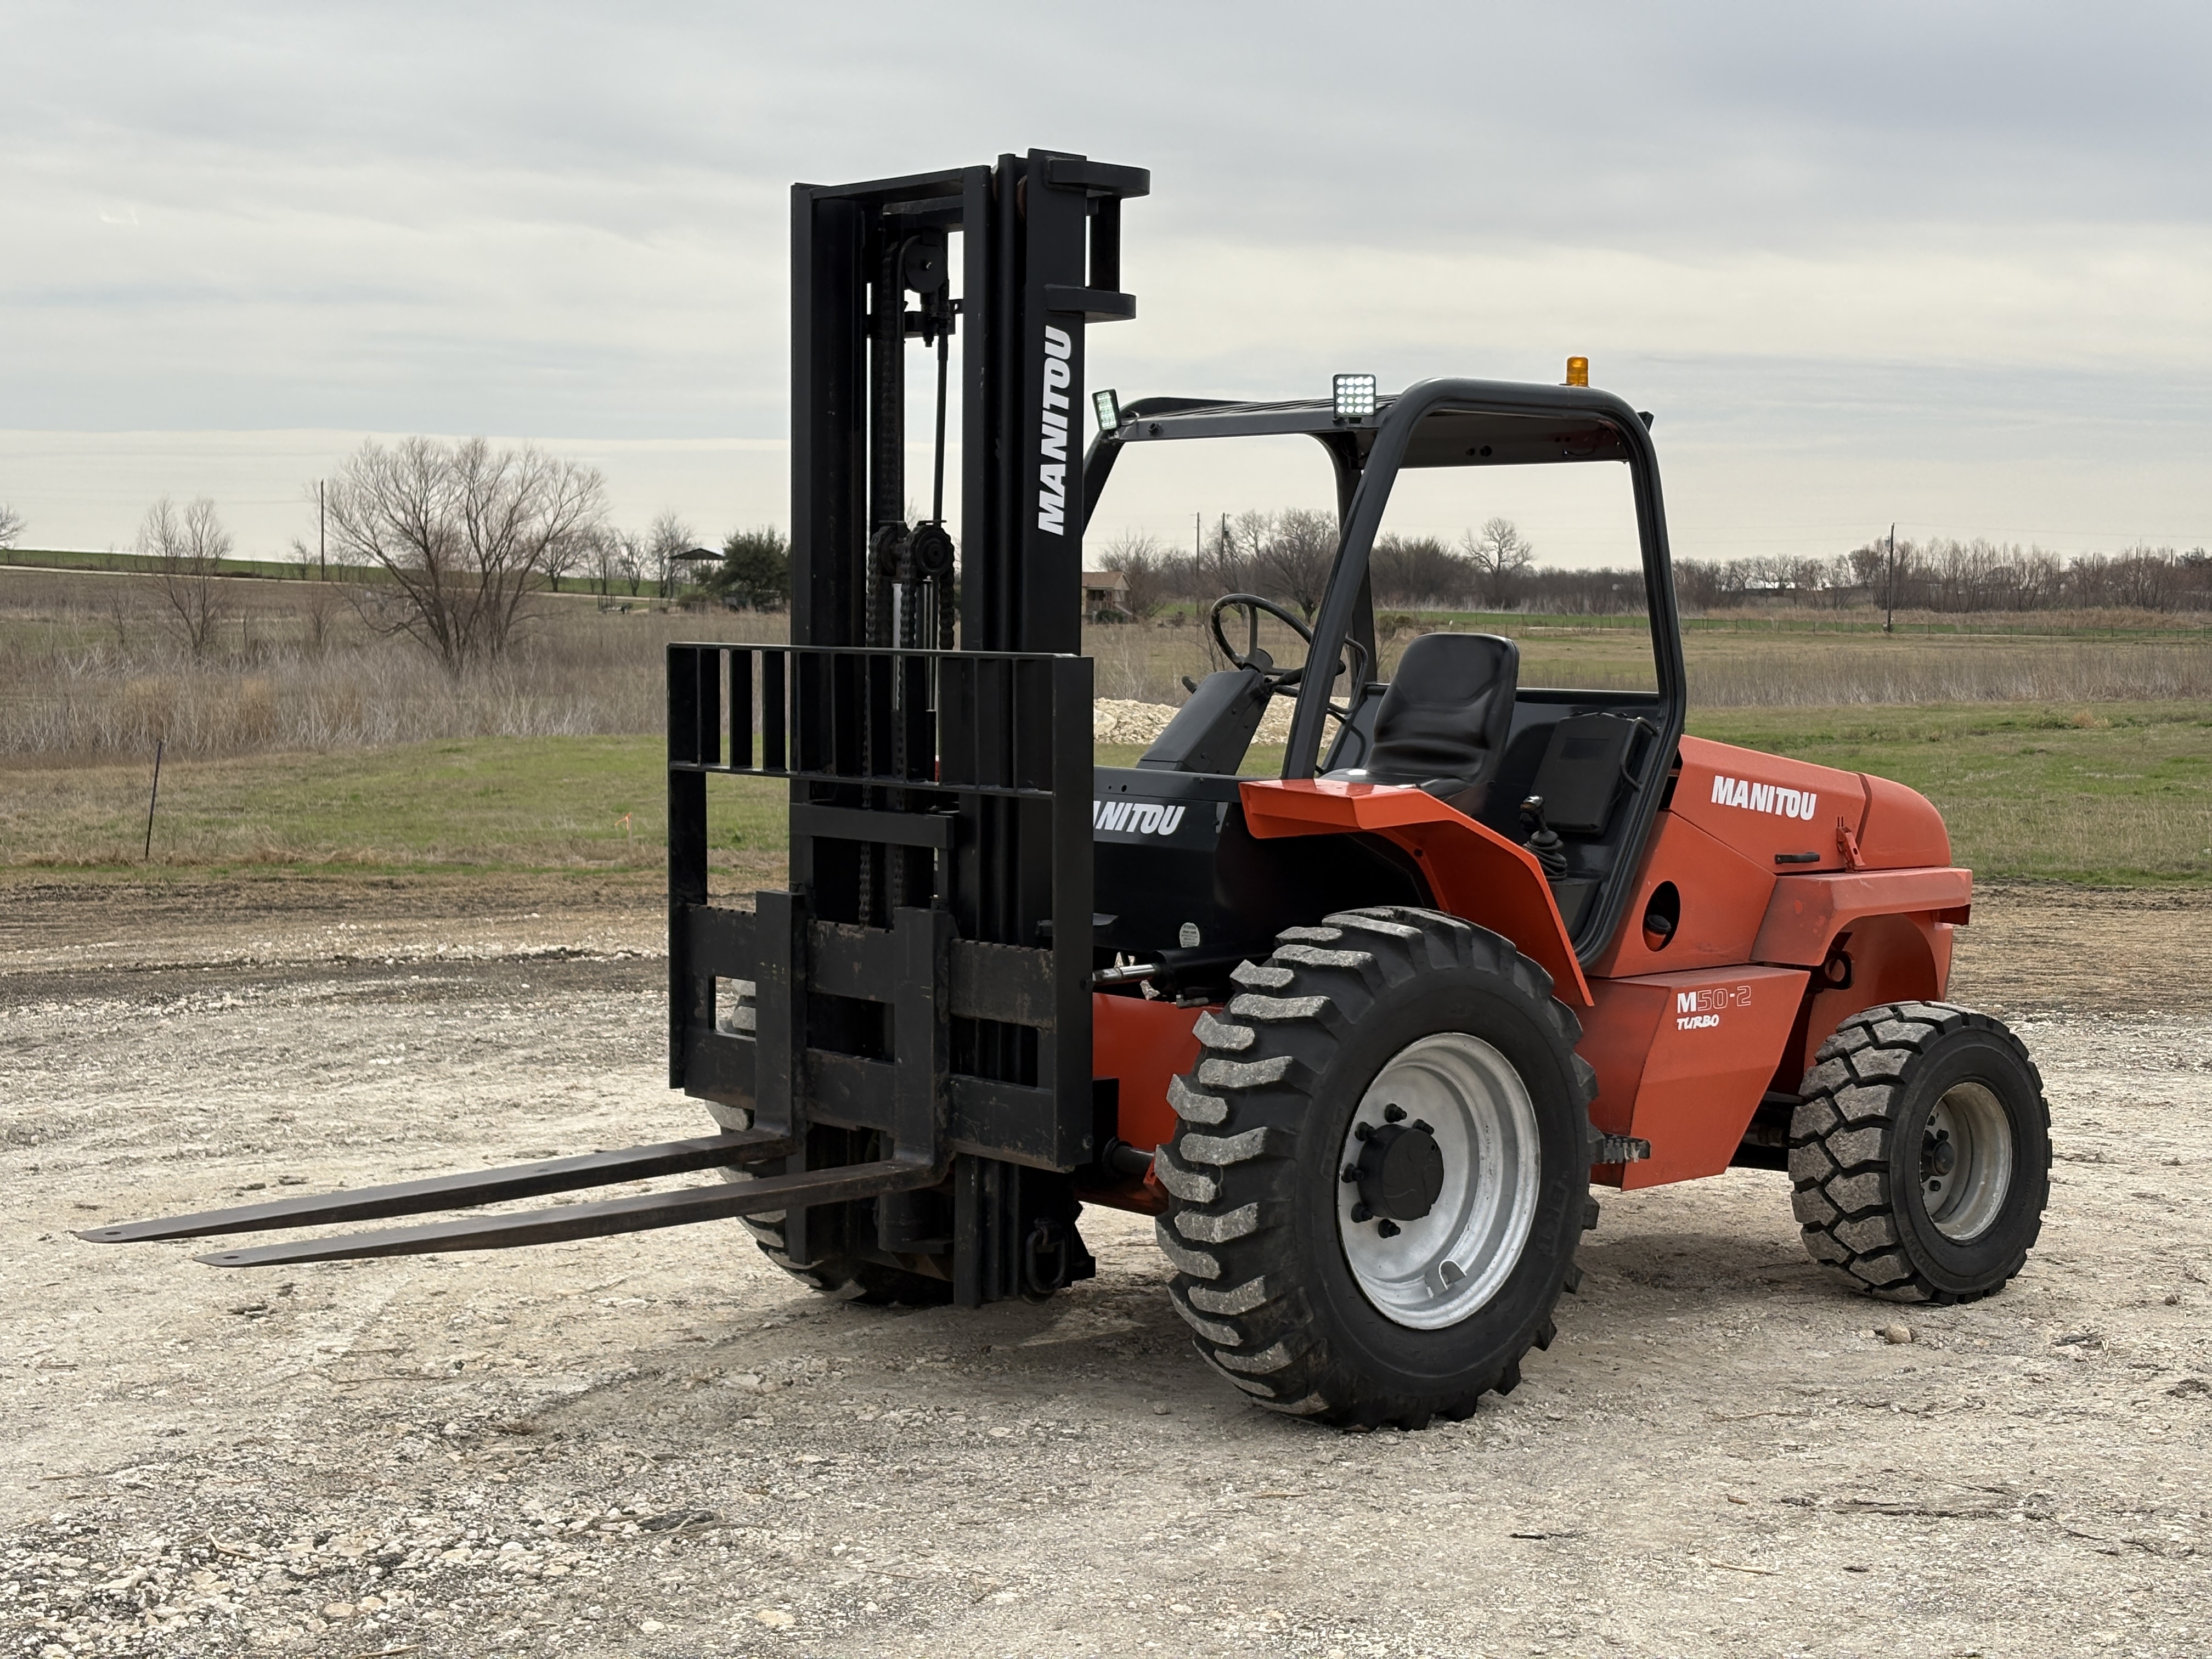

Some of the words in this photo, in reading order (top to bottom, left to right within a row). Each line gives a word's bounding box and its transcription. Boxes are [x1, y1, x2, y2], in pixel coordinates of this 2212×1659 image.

[1038, 325, 1071, 536] MANITOU
[1711, 775, 1817, 821] MANITOU
[1093, 800, 1186, 836] NITOU
[1677, 985, 1751, 1014] M50-2
[1677, 1014, 1719, 1030] TURBO
